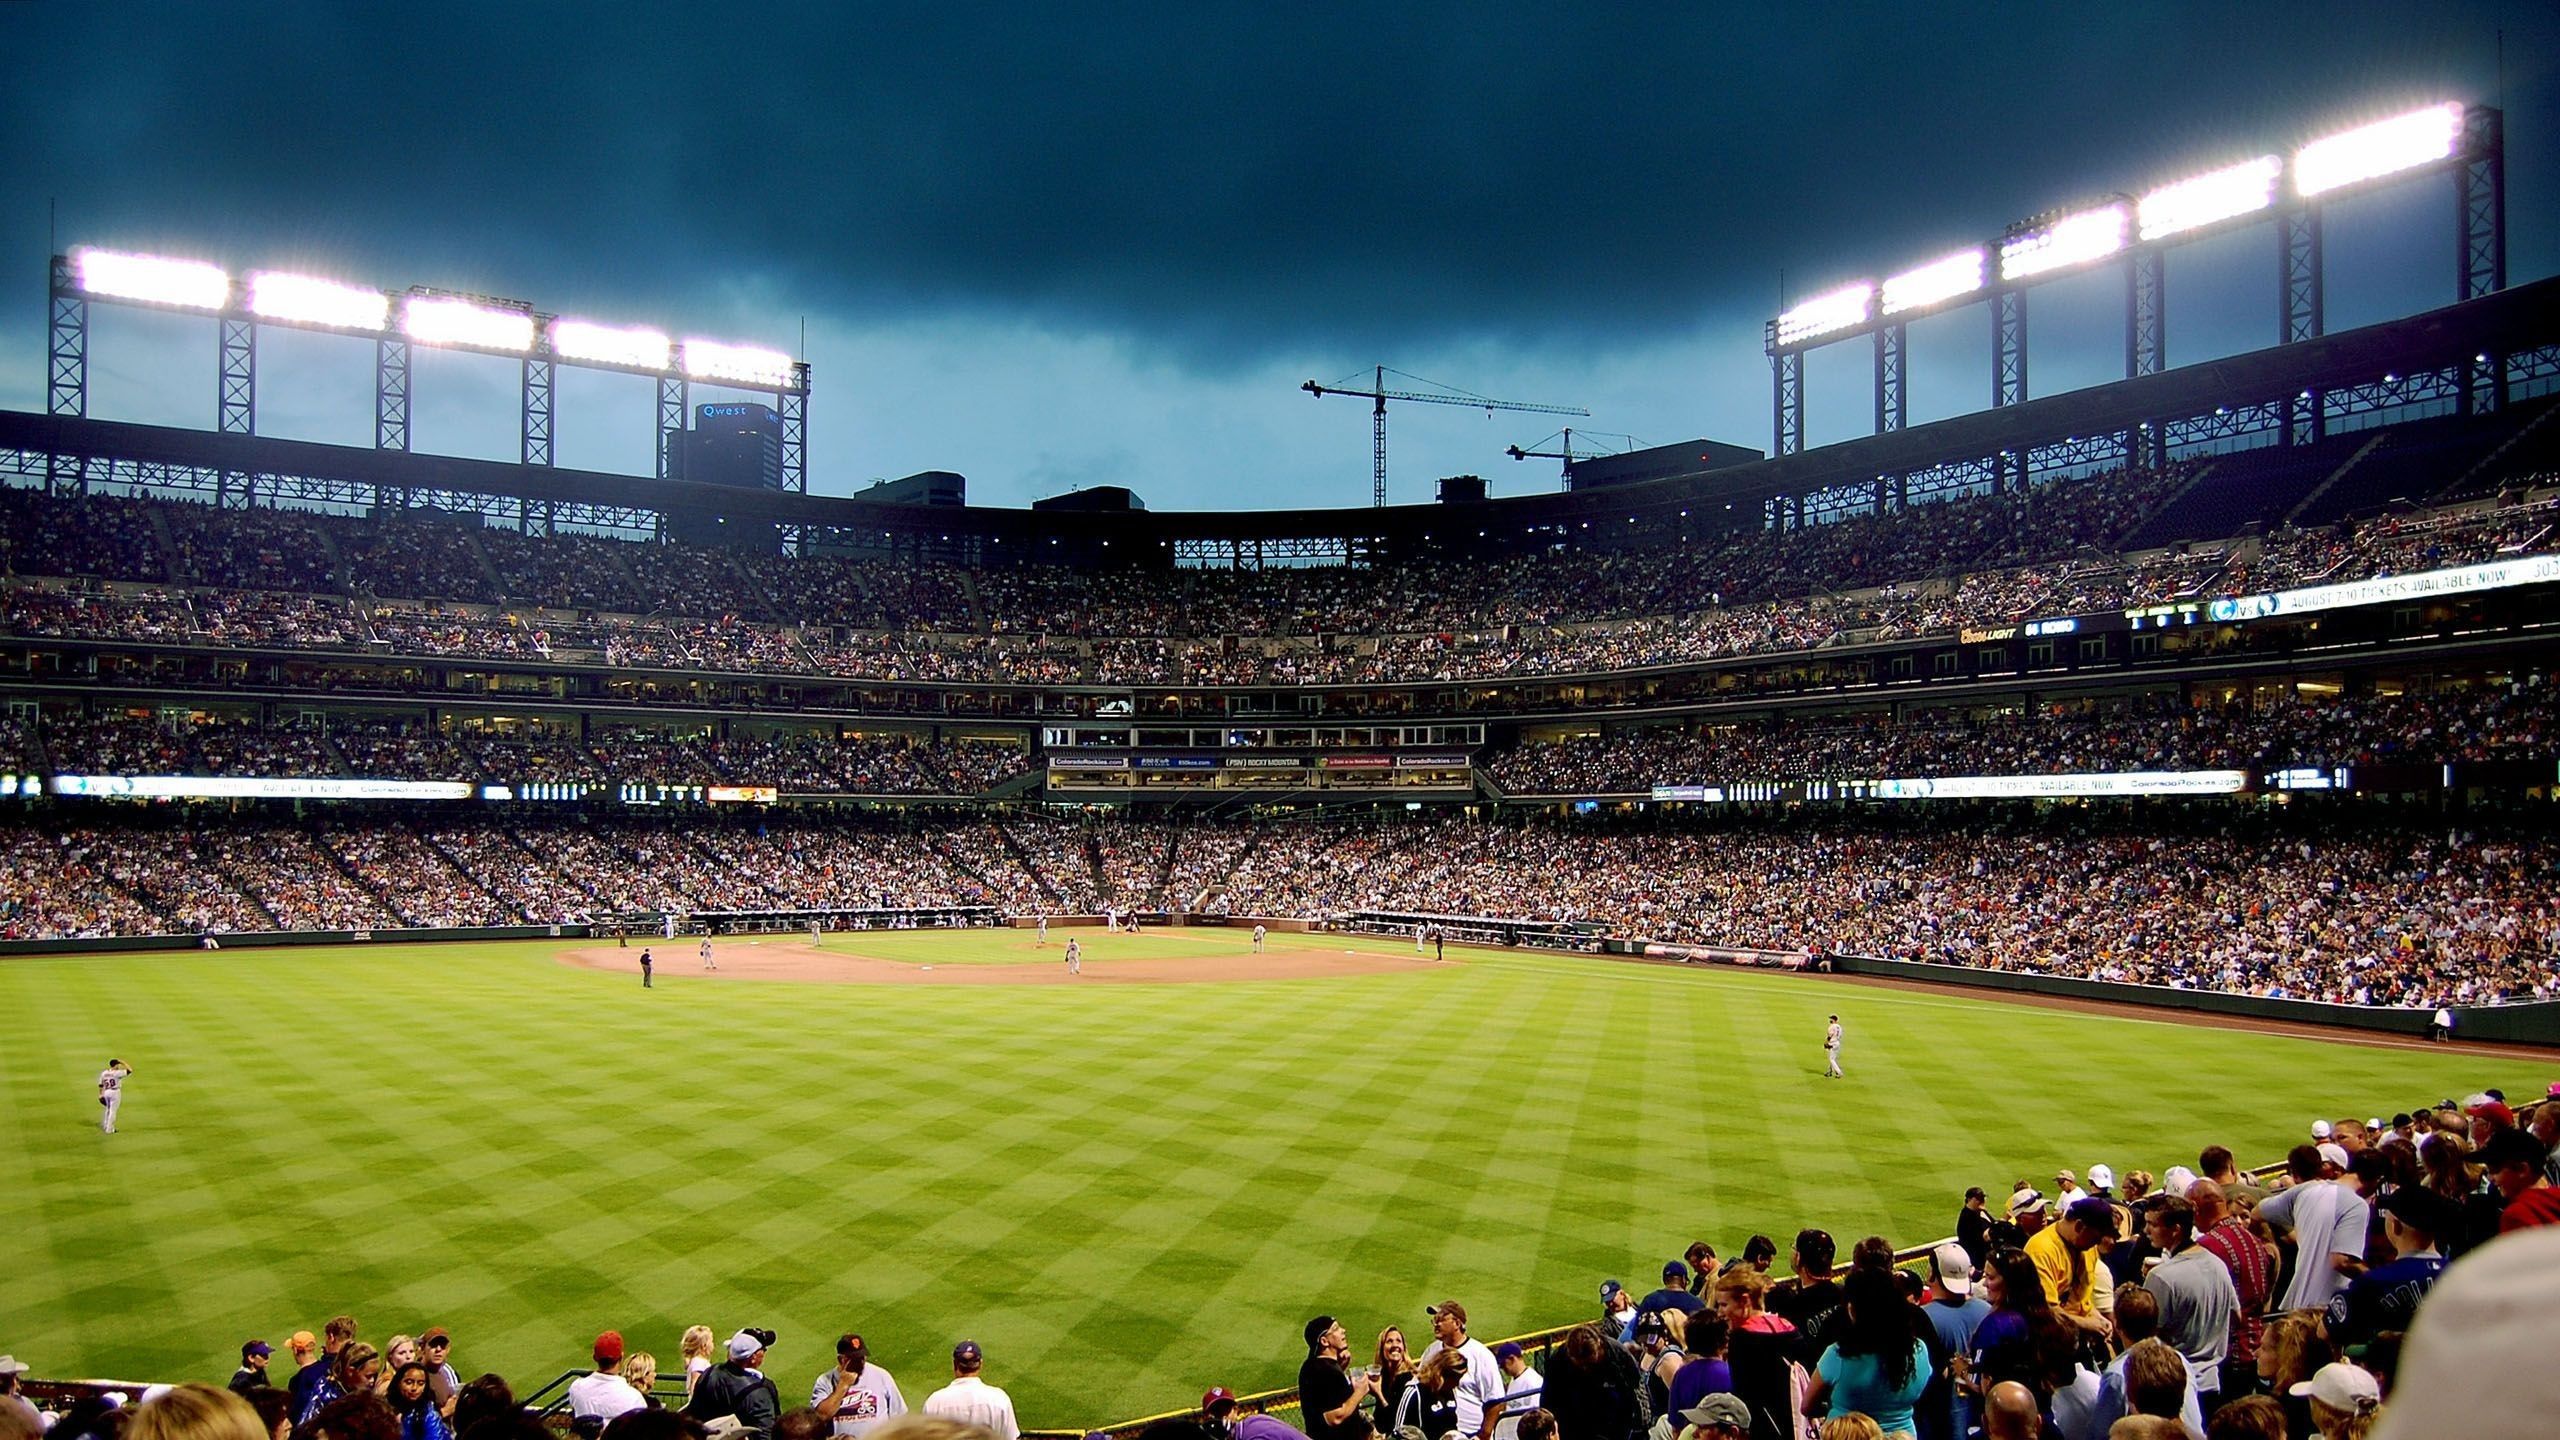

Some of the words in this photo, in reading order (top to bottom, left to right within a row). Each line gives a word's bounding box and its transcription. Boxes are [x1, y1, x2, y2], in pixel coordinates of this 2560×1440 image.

[704, 404, 746, 417] Qwest
[2291, 592, 2331, 608] AUGUST
[2361, 582, 2407, 599] TICKETS
[2411, 574, 2472, 592] AVAILABLE
[1987, 629, 2016, 640] LIGHT
